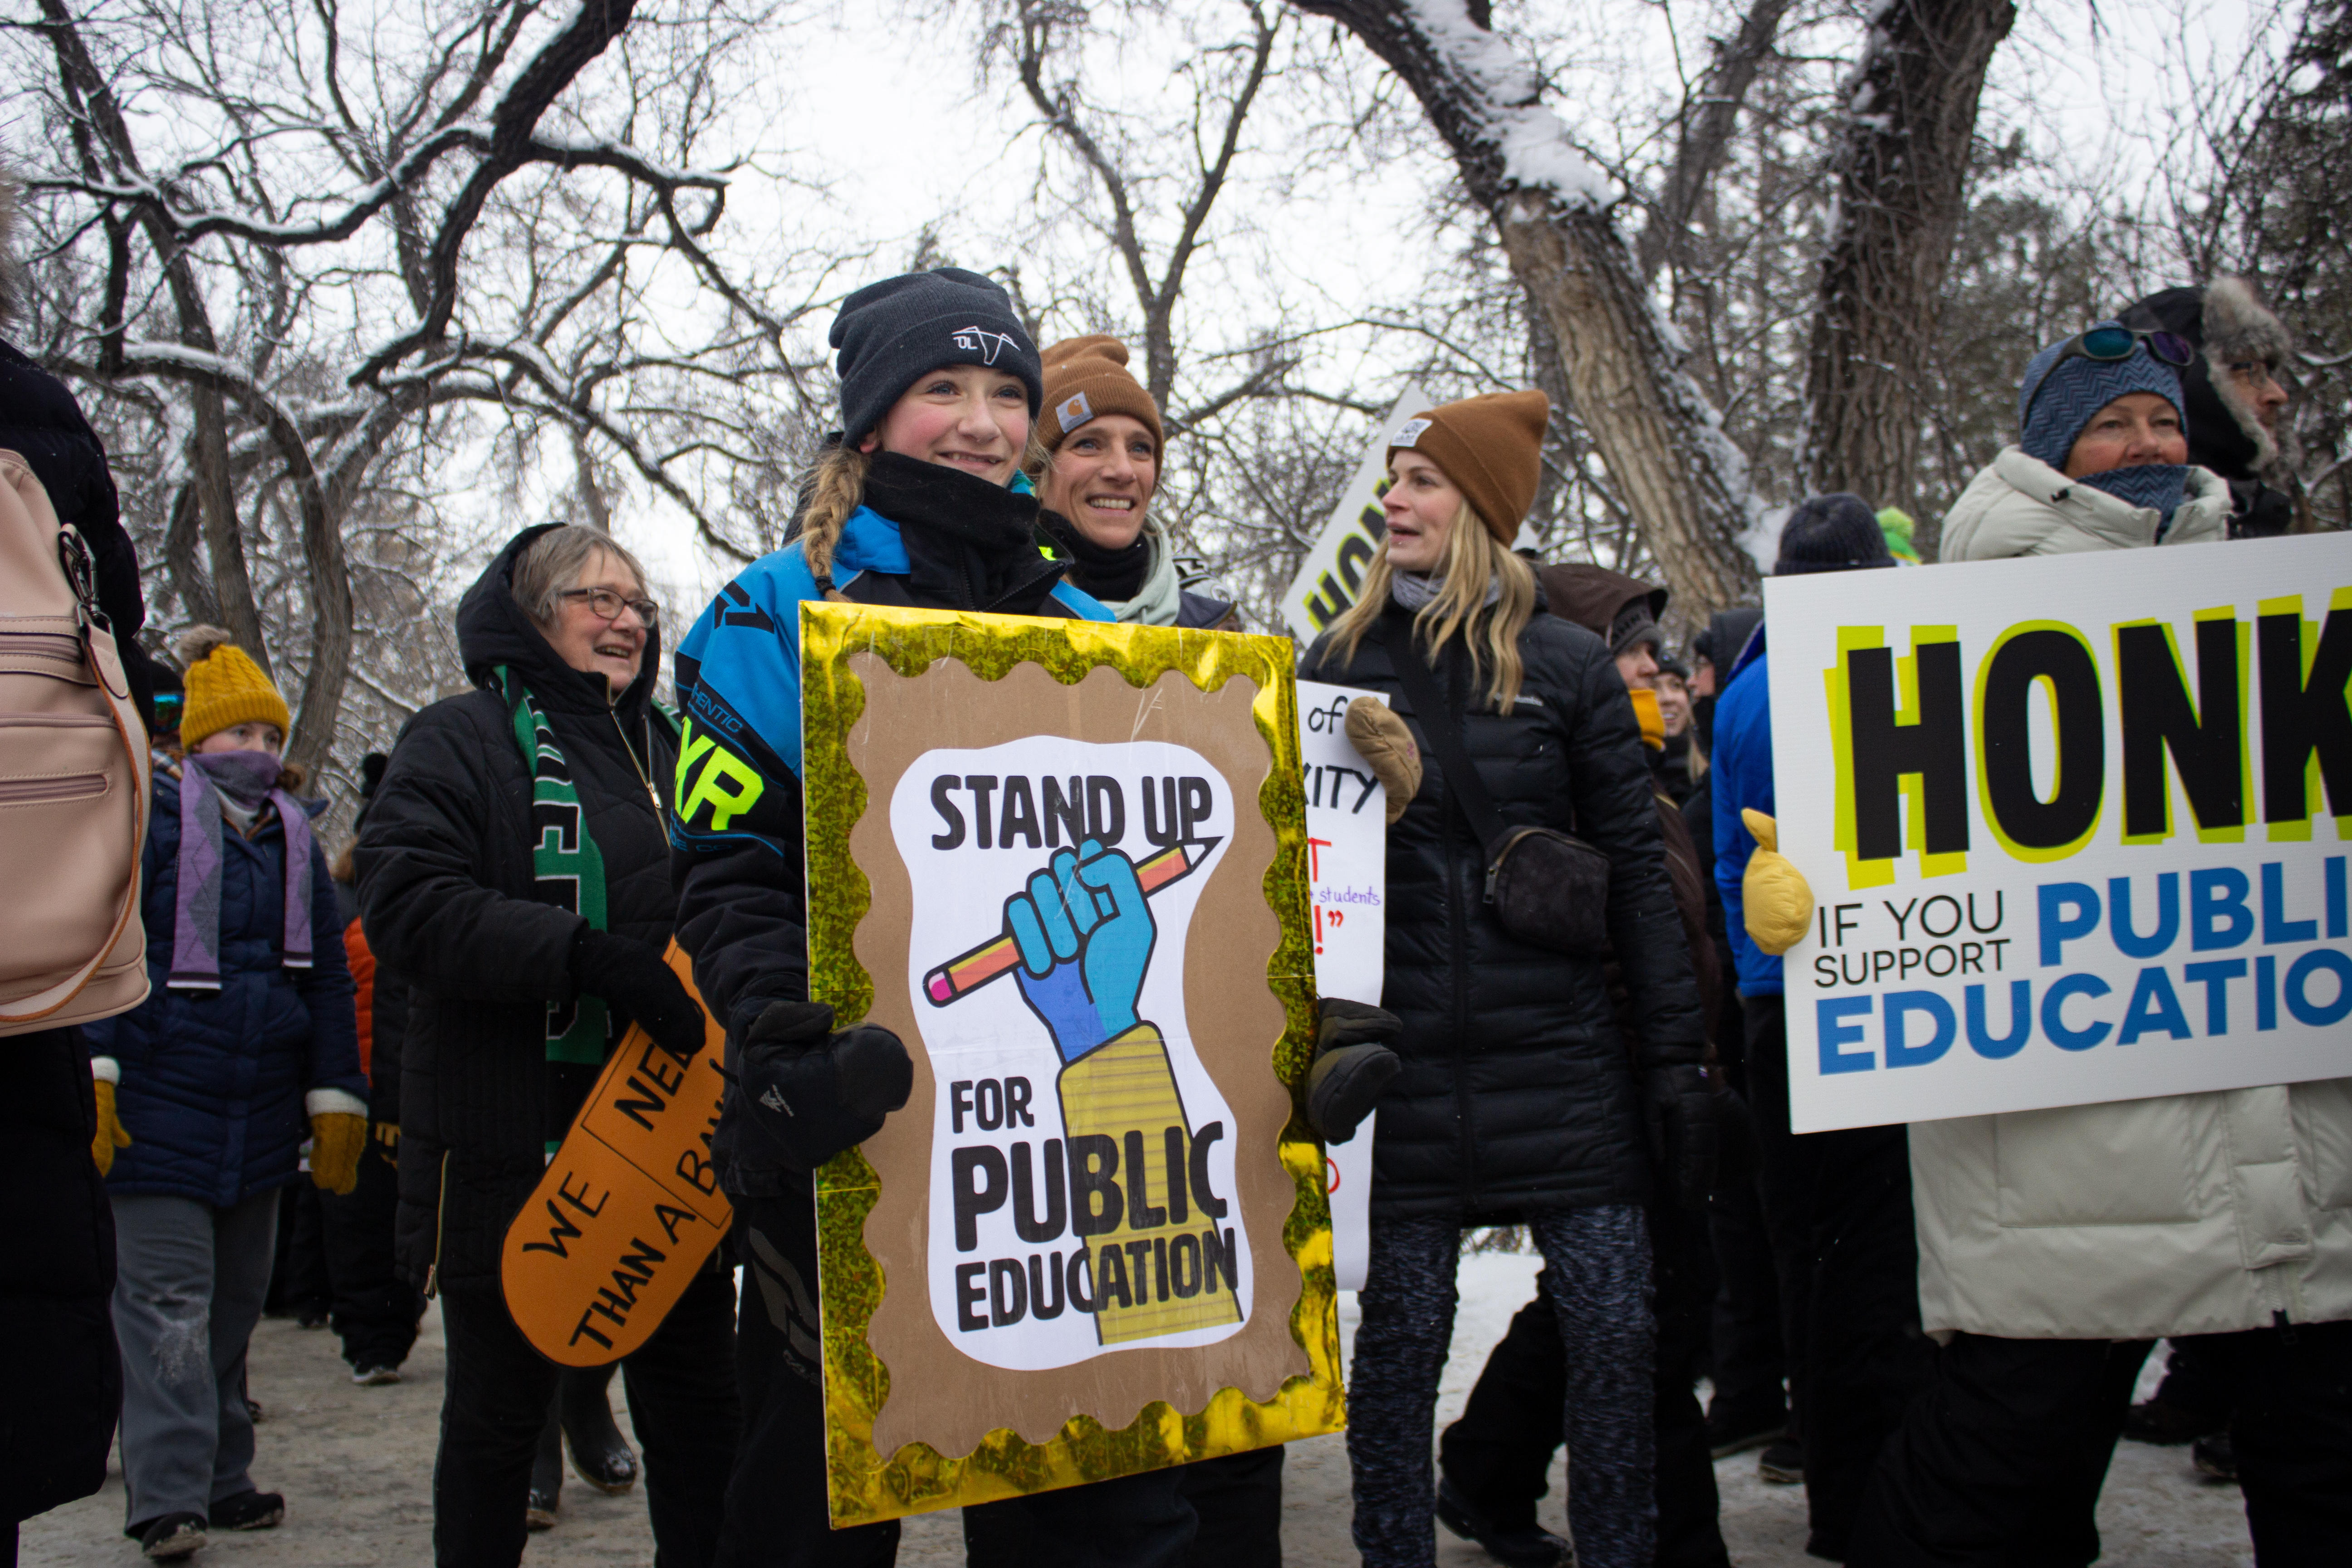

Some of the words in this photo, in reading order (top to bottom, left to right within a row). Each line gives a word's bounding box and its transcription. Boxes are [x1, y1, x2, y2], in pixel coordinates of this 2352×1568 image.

[1308, 695, 1348, 735] of
[1847, 608, 2352, 862] HONK
[930, 774, 1126, 851] STAND
[1141, 775, 1213, 848] UP
[1318, 886, 1381, 906] students
[1818, 902, 1863, 948] IF
[1883, 890, 2004, 941] YOU
[2036, 855, 2348, 968] PUBLI
[1813, 938, 2011, 988] SUPPORT
[1816, 948, 2352, 1076] EDUCATIO
[951, 1076, 1034, 1134] FOR
[522, 1171, 610, 1259] WE
[951, 1121, 1228, 1252] PUBLIC
[568, 1236, 666, 1351] THAN
[653, 1204, 697, 1246] A
[955, 1227, 1239, 1333] EDUCATION
